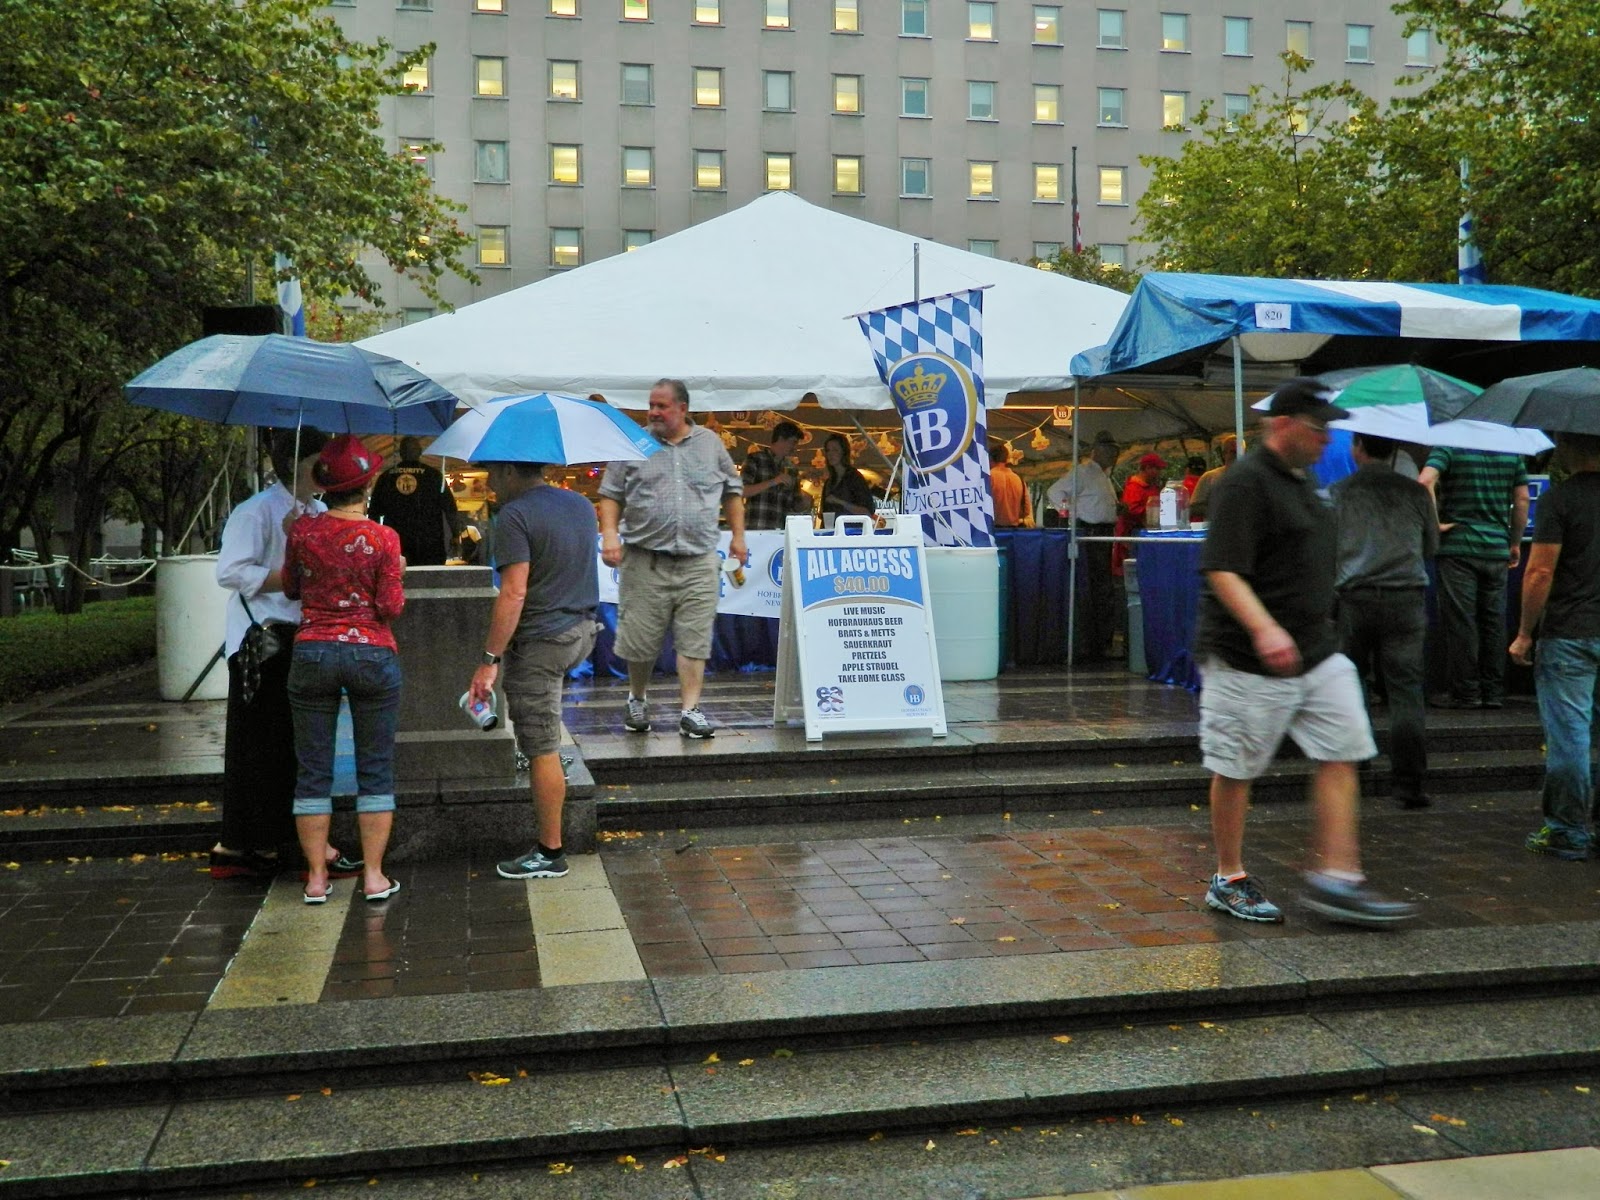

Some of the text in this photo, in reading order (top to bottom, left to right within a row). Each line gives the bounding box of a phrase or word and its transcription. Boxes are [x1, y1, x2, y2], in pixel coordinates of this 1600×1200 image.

[1265, 311, 1283, 321] 820
[903, 408, 952, 454] HB
[807, 550, 837, 581] ALL
[841, 548, 913, 579] ACCESS
[834, 576, 889, 594] $40.00
[843, 606, 886, 615] LIVE MUSIC
[828, 617, 903, 627] HOFBRAUHAUS BEER
[838, 629, 863, 638] BRATS
[871, 629, 896, 637] METTS
[843, 640, 892, 649] SAUERKRAUT
[852, 651, 887, 660] PRETZELS
[842, 662, 899, 672] APPLE STRUDEL
[838, 673, 906, 683] TAKE HOME GLASS
[910, 694, 920, 703] HB
